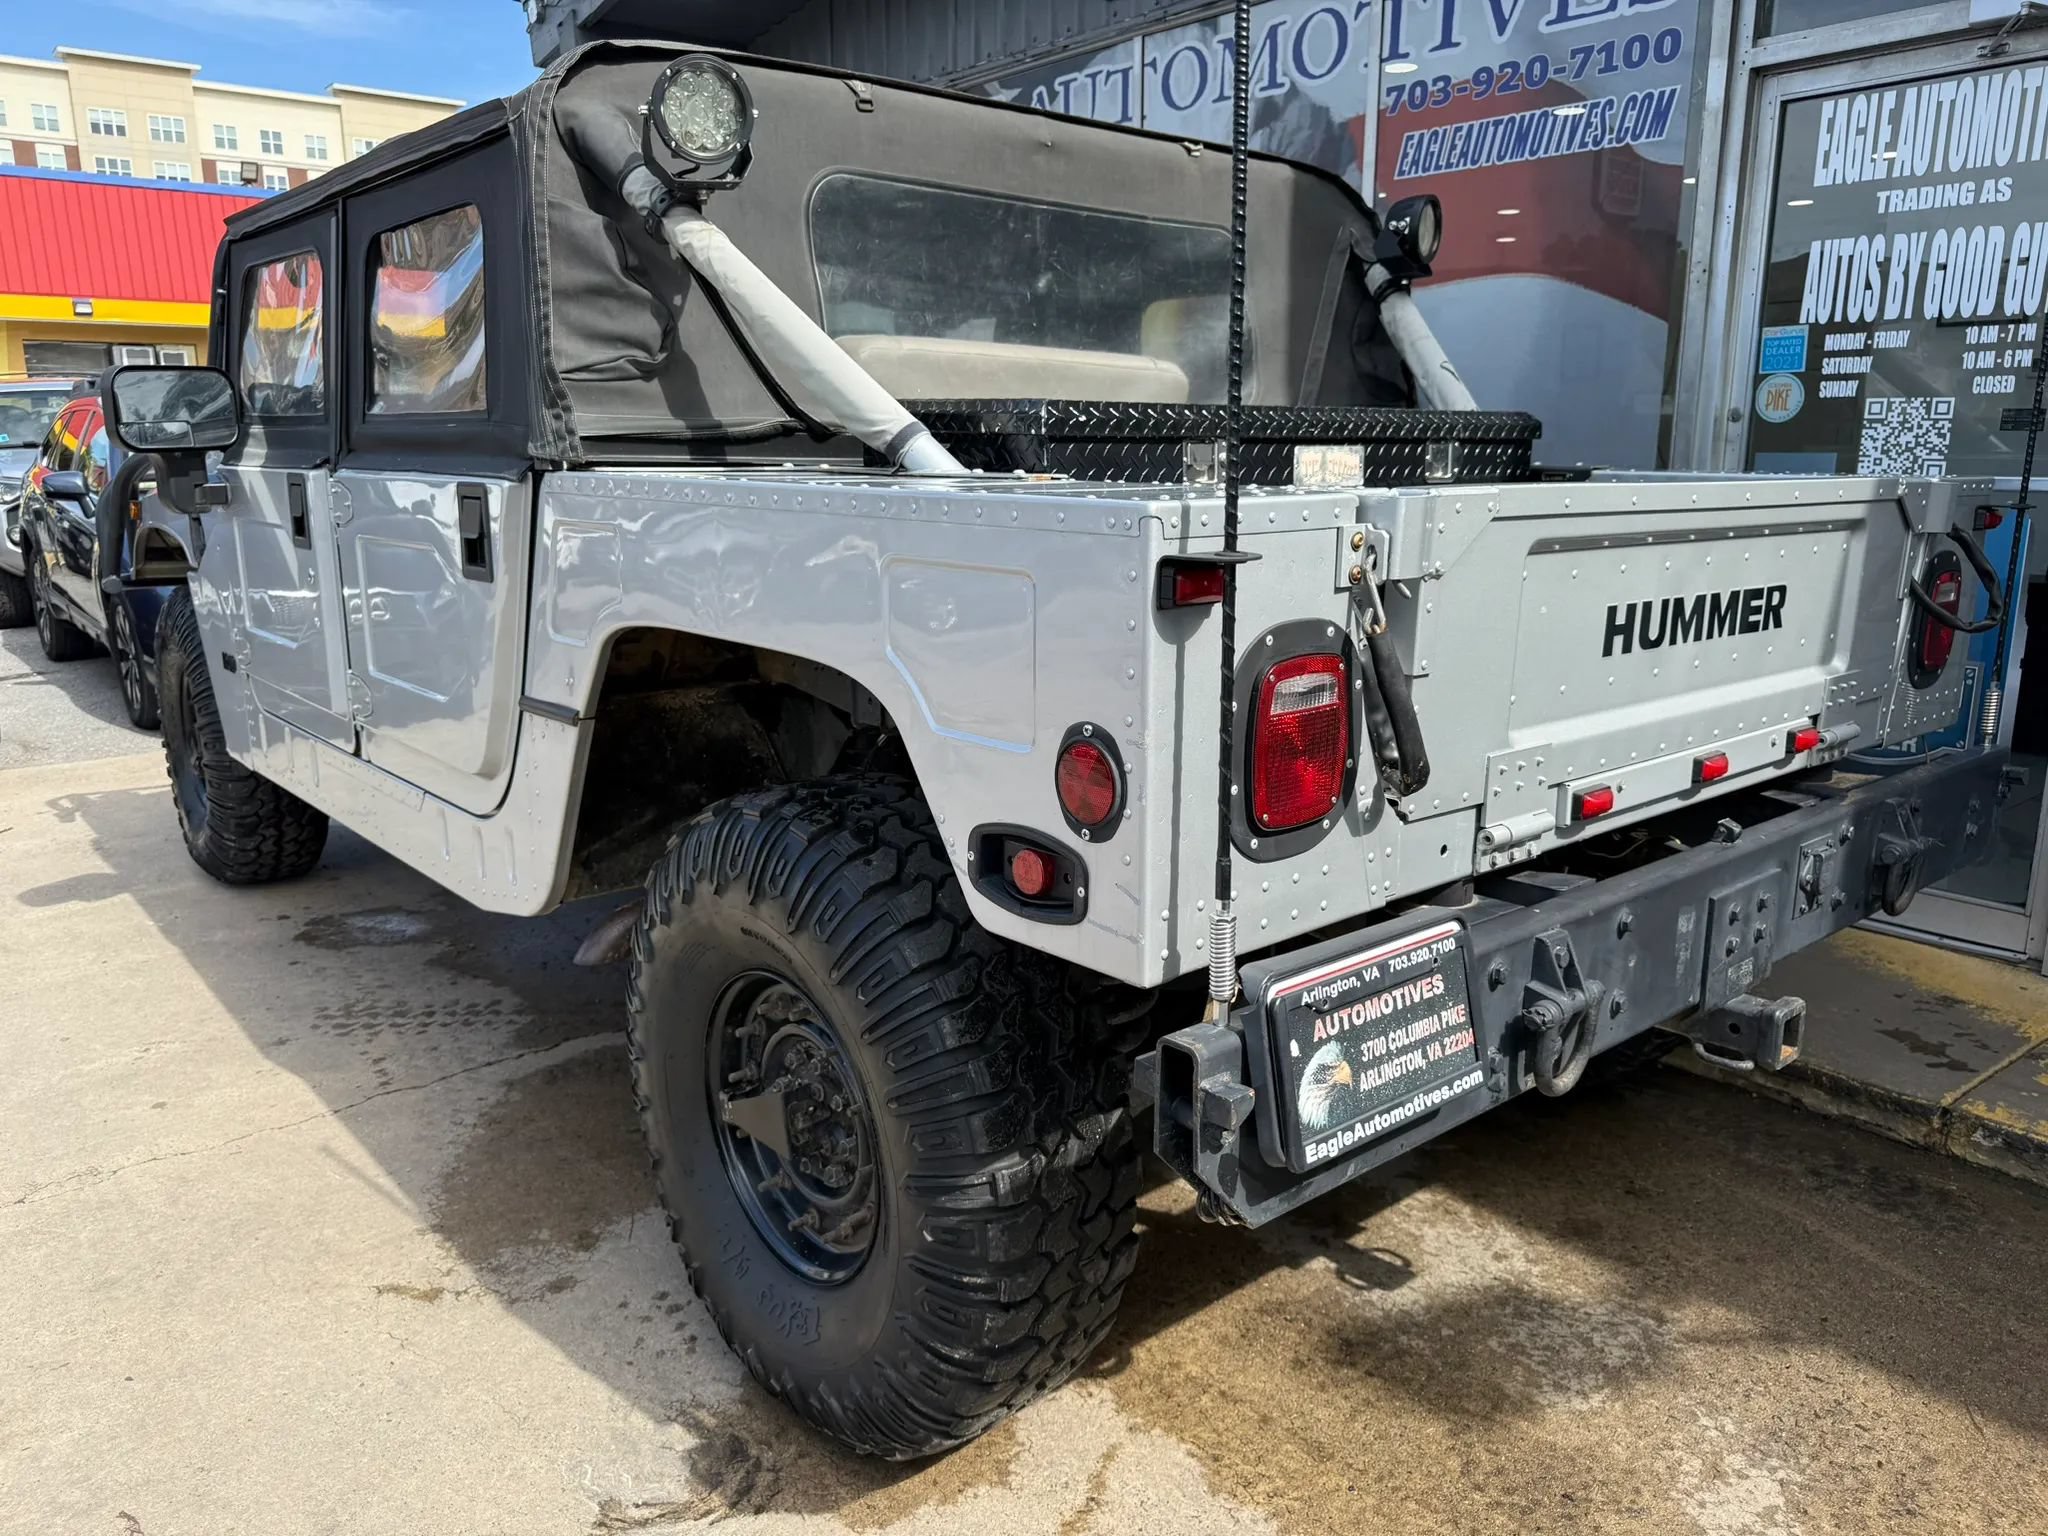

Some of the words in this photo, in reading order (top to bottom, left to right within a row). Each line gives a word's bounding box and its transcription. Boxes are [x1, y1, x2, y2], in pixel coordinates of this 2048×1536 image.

[1031, 0, 1674, 124] UTOMOTIV
[1386, 27, 1683, 116] 703-920-7100
[1395, 86, 1680, 180] EAGLEAUTOMOTIVES.COM
[1813, 90, 1897, 187] EAGLE
[1892, 65, 2048, 178] AUTOMOTI
[1876, 183, 1975, 214] TRADING
[1979, 176, 2013, 204] AS
[1799, 233, 1887, 325] AUTOS
[1883, 231, 1928, 321] BY
[1923, 225, 2006, 320] GOOD
[2003, 222, 2048, 317] GU
[1766, 346, 1801, 355] DEALER
[1766, 356, 1799, 370] 2021
[1824, 332, 1868, 352] MONDAY
[1873, 329, 1911, 350] FRIDAY
[1962, 352, 1976, 370] 10
[1976, 350, 1995, 369] AM
[2003, 349, 2012, 368] 6
[2014, 349, 2033, 367] PM
[1965, 326, 1979, 345] 10
[1978, 325, 1998, 344] AM
[2007, 324, 2015, 342] 7
[2018, 323, 2038, 342] PM
[1819, 380, 1859, 399] SUNDAY
[1821, 356, 1874, 376] SATURDAY
[1972, 375, 2016, 394] CLOSED
[1765, 389, 1792, 411] PIKE
[1601, 584, 1787, 658] HUMMER
[1301, 974, 1361, 1006] Arlington,
[1362, 965, 1381, 983] VA
[1388, 937, 1456, 973] 703.920.7100
[1313, 973, 1445, 1042] AUTOMOTIVES
[1361, 1036, 1387, 1062] 3700
[1387, 1015, 1440, 1051] COLUMBIA
[1440, 1004, 1467, 1029] PIKE
[1359, 1050, 1427, 1093] ARLINGTON,
[1427, 1042, 1443, 1061] VA
[1443, 1028, 1475, 1057] 22204
[1304, 1068, 1484, 1165] EagleAutomotives.com
